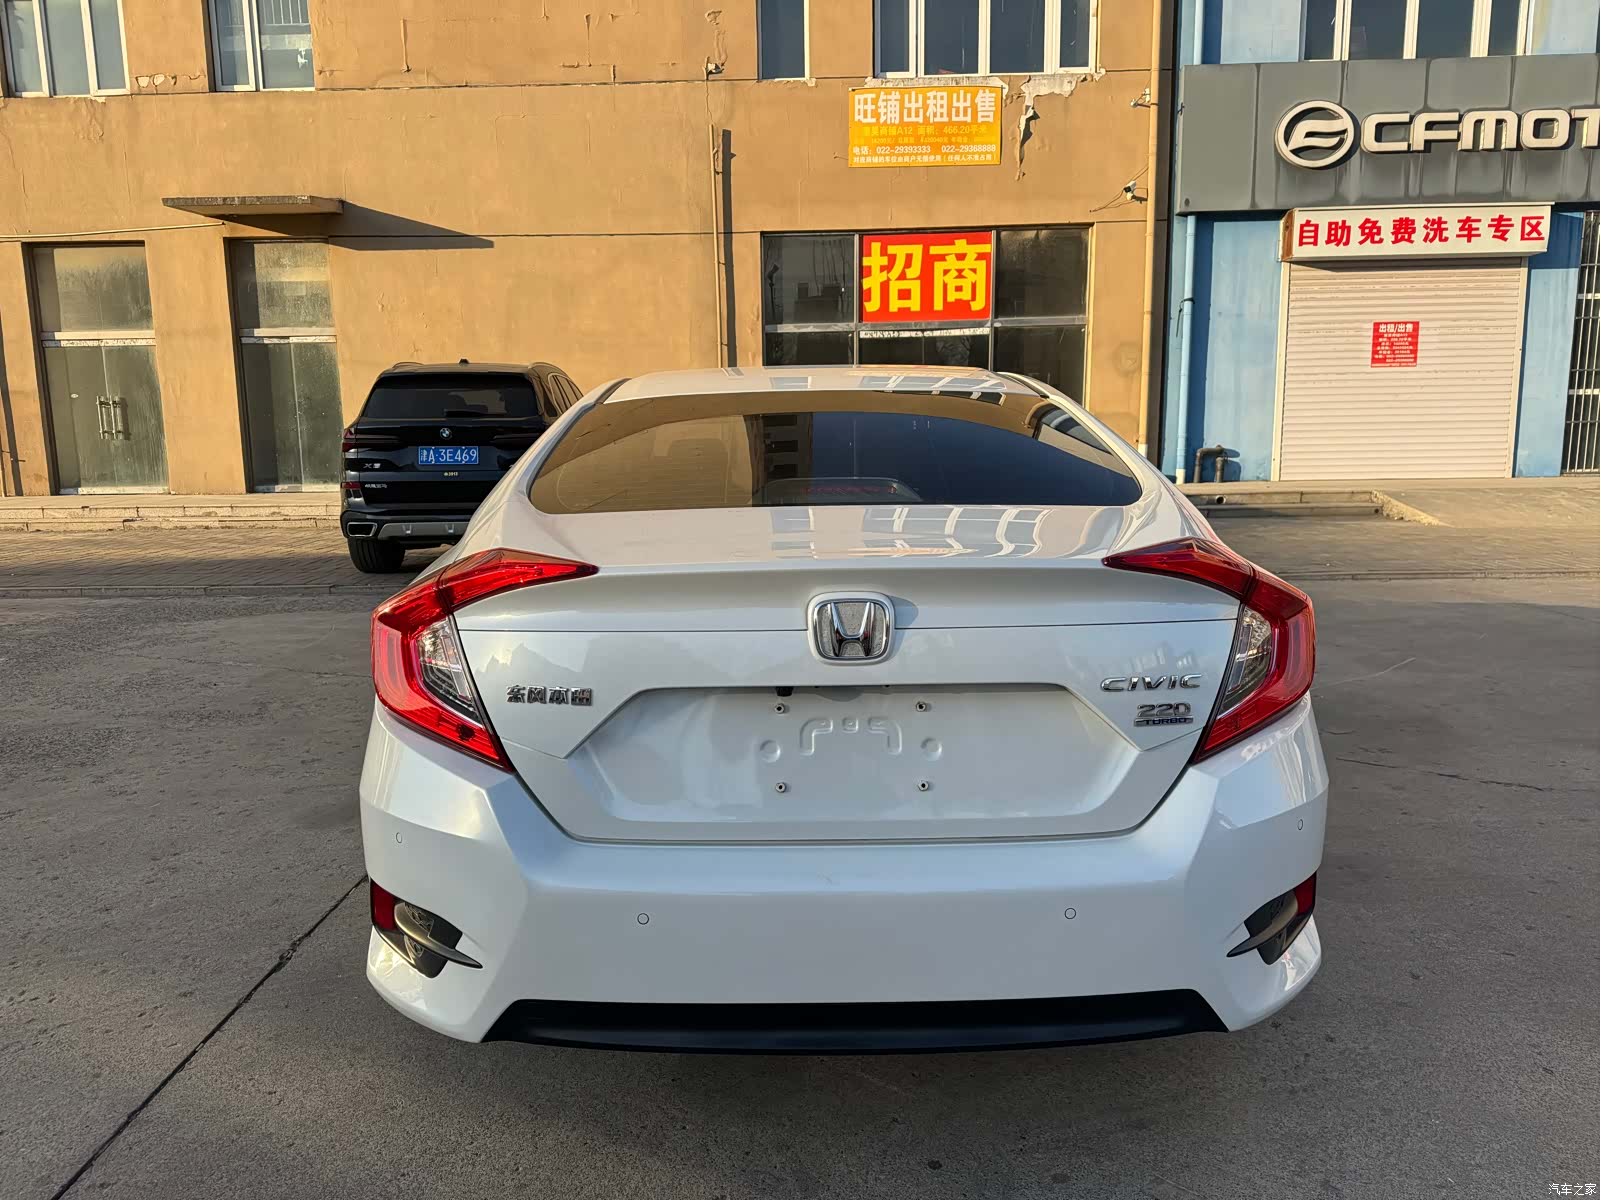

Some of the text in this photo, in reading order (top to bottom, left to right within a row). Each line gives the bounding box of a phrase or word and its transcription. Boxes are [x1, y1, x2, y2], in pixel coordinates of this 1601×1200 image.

[854, 89, 996, 124] 旺铺出租出售
[1298, 214, 1546, 247] 自助免费洗车专区
[861, 239, 992, 313] 招商
[1101, 673, 1203, 692] CIVIC
[507, 685, 593, 706] 东风本田
[1137, 702, 1191, 717] 220
[1144, 717, 1188, 725] TURBO
